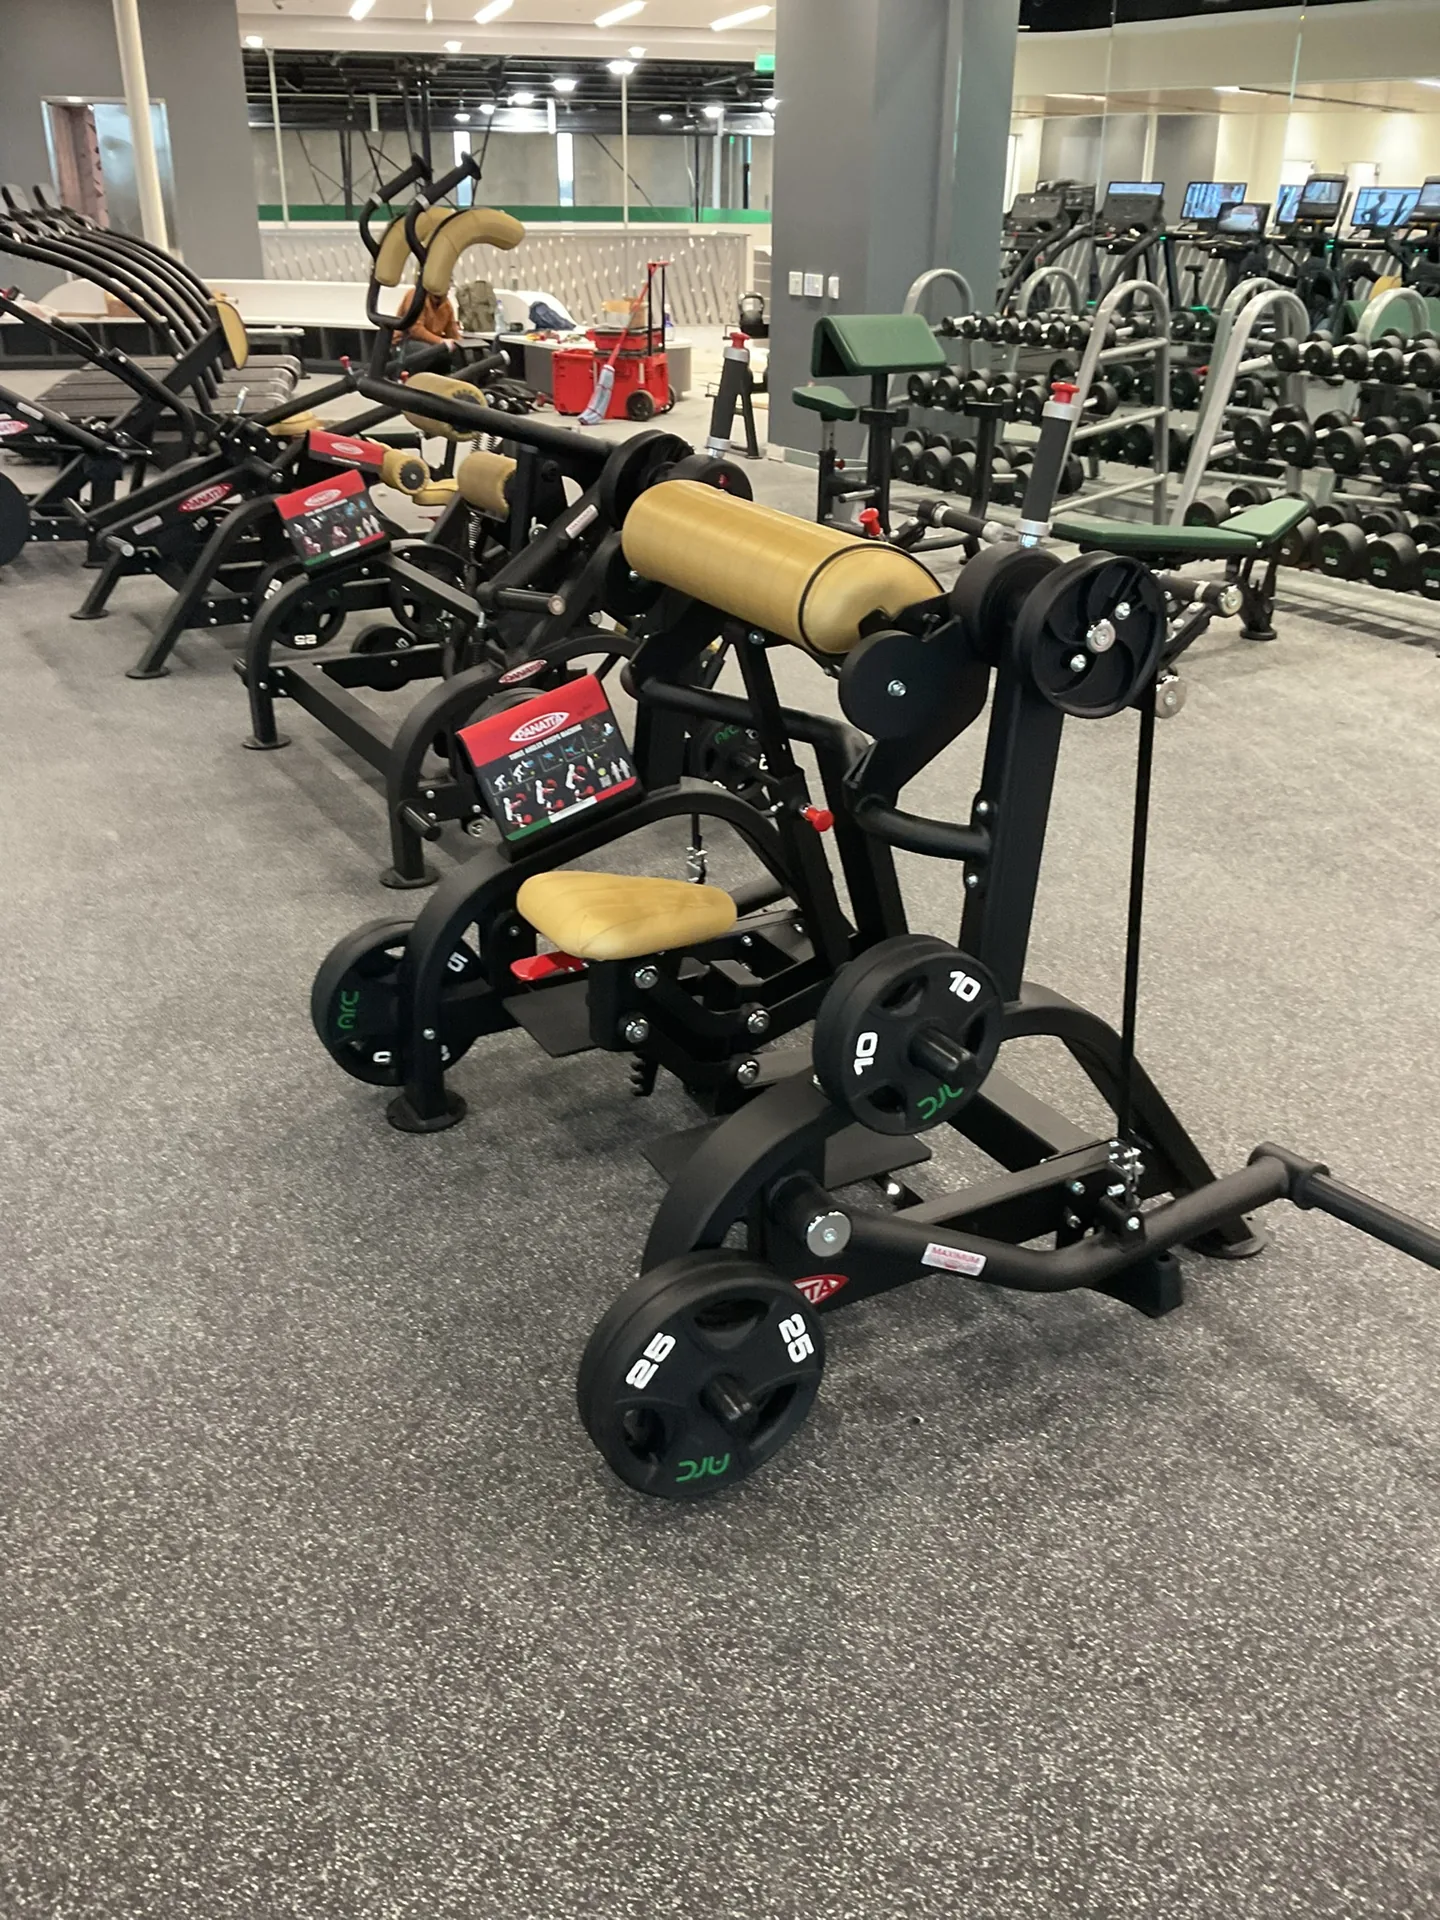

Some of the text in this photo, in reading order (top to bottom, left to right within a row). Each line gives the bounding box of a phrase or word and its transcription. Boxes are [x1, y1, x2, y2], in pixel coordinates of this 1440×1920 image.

[517, 714, 562, 740] PANATTA
[447, 951, 469, 973] 5
[948, 970, 982, 1003] 10
[853, 1031, 878, 1076] 10
[778, 1313, 815, 1363] 25
[625, 1332, 677, 1390] 25
